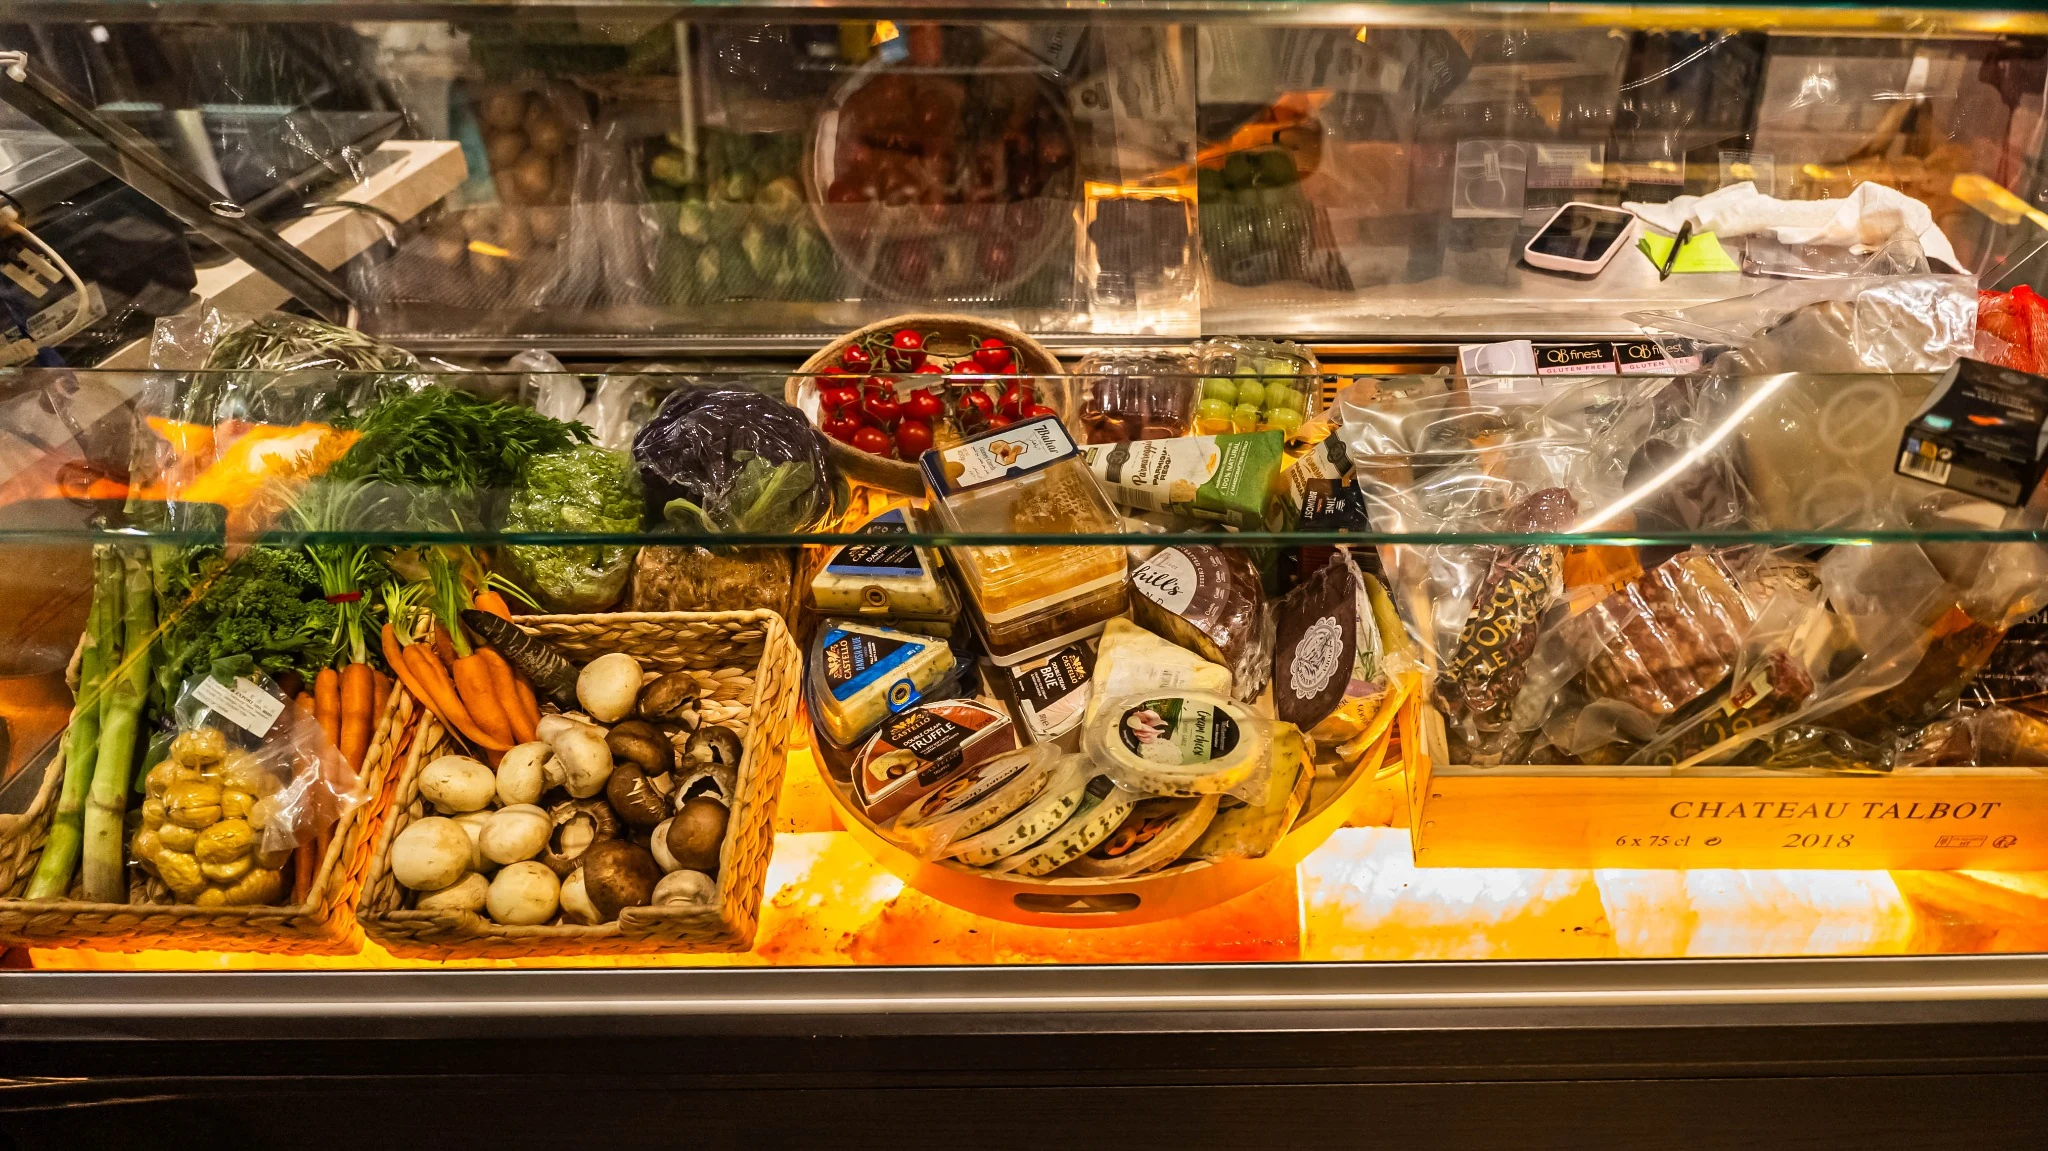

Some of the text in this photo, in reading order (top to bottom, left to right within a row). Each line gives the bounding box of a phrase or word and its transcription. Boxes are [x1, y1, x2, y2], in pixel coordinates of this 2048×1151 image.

[1570, 349, 1602, 359] finest
[1629, 361, 1664, 370] GLUTEN
[1221, 442, 1241, 489] 100% NATURAL
[1305, 491, 1318, 519] BRUNOST
[1325, 497, 1336, 514] TINE
[840, 640, 852, 680] CASTELLO
[852, 636, 865, 671] DANISH BLUE
[1040, 667, 1058, 689] BRIE
[1051, 661, 1067, 691] DOUBLE CREAM
[1062, 655, 1078, 684] CASTELLO
[891, 717, 931, 741] CASTELLO
[903, 723, 942, 746] DOUBLE CREAM
[909, 722, 956, 751] TRUFFLE
[1192, 710, 1211, 757] Cream cheese
[1669, 801, 2002, 819] CHATEAU TALBOT
[1615, 835, 1690, 847] 6 x 75 cl
[1781, 833, 1855, 848] 2018
